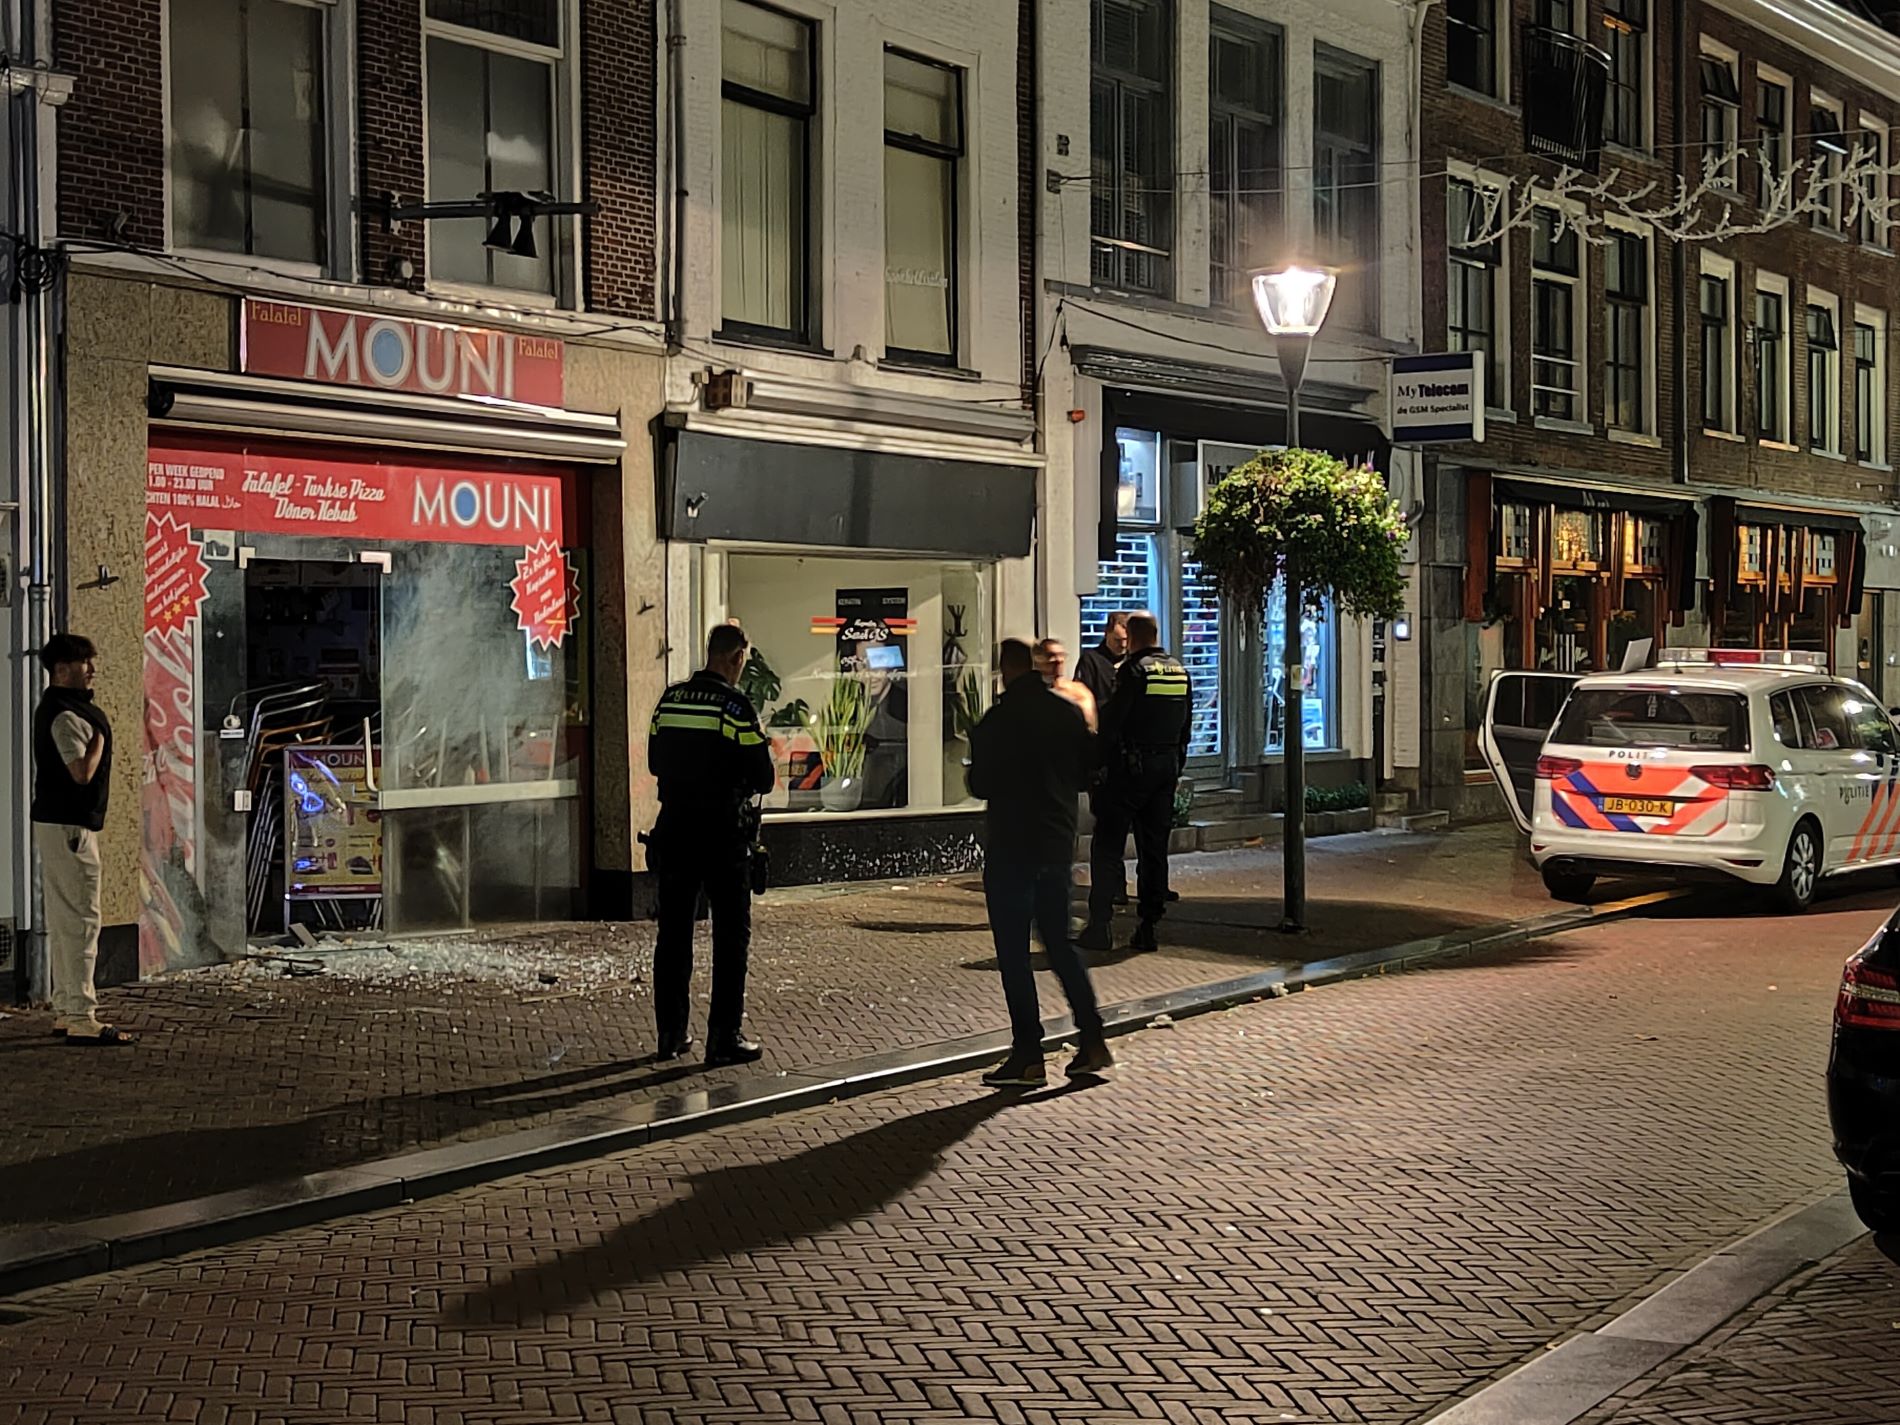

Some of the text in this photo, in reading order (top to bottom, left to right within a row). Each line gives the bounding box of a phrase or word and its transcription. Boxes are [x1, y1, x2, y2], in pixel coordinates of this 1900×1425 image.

[252, 301, 301, 327] Falafel
[304, 308, 515, 400] MOUNI
[519, 337, 559, 361] Falafel
[1409, 405, 1429, 414] GSM
[1430, 403, 1469, 416] Specialist
[165, 464, 189, 477] WEEK
[242, 470, 295, 498] Falafel
[303, 475, 349, 499] Turkse
[349, 479, 386, 501] Pizza
[172, 493, 195, 506] 100%
[196, 495, 219, 508] HALAL
[317, 500, 357, 522] Kebab
[411, 474, 552, 534] MOUNI
[1609, 750, 1661, 761] POLIT
[1608, 799, 1668, 813] JB-030-K
